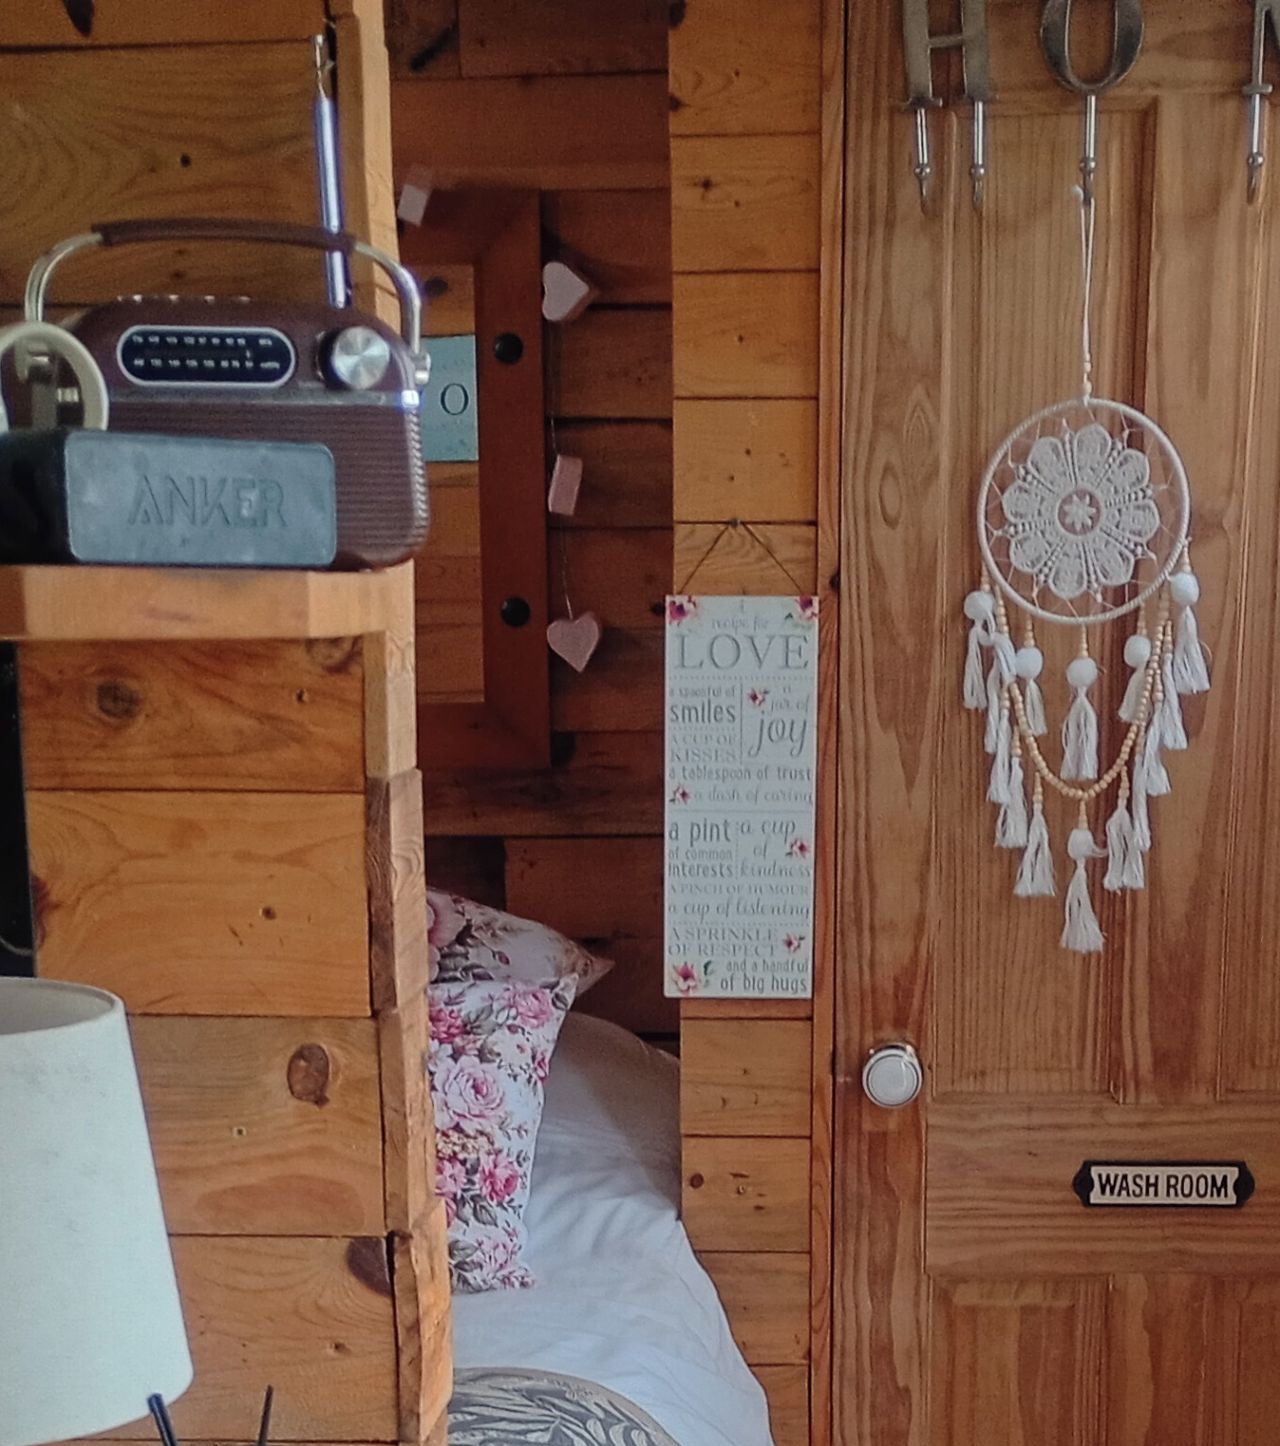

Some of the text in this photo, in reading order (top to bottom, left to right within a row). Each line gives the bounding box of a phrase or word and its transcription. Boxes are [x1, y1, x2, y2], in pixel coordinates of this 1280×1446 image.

[127, 473, 288, 528] ANKER
[674, 632, 810, 670] LOVE
[725, 684, 737, 698] of
[669, 697, 737, 725] smiles
[747, 708, 809, 759] joy
[670, 748, 737, 763] KISSES
[682, 764, 752, 784] tablespoon
[756, 764, 769, 780] of
[777, 765, 812, 781] trust
[708, 785, 740, 801] dash
[745, 785, 760, 806] of
[668, 817, 732, 848] a pint
[740, 819, 797, 845] a cup
[668, 846, 734, 861] of common
[753, 839, 769, 862] of
[668, 861, 734, 878] interests
[740, 857, 812, 878] kindness
[683, 902, 711, 925] cup
[716, 896, 732, 919] of
[736, 896, 810, 920] listening
[684, 927, 777, 942] SPRINKLE
[668, 943, 776, 957] OF RESPECT
[726, 958, 746, 973] and
[762, 958, 809, 973] handful
[720, 972, 808, 994] of big hugs
[1097, 1173, 1229, 1198] WASH ROOM
